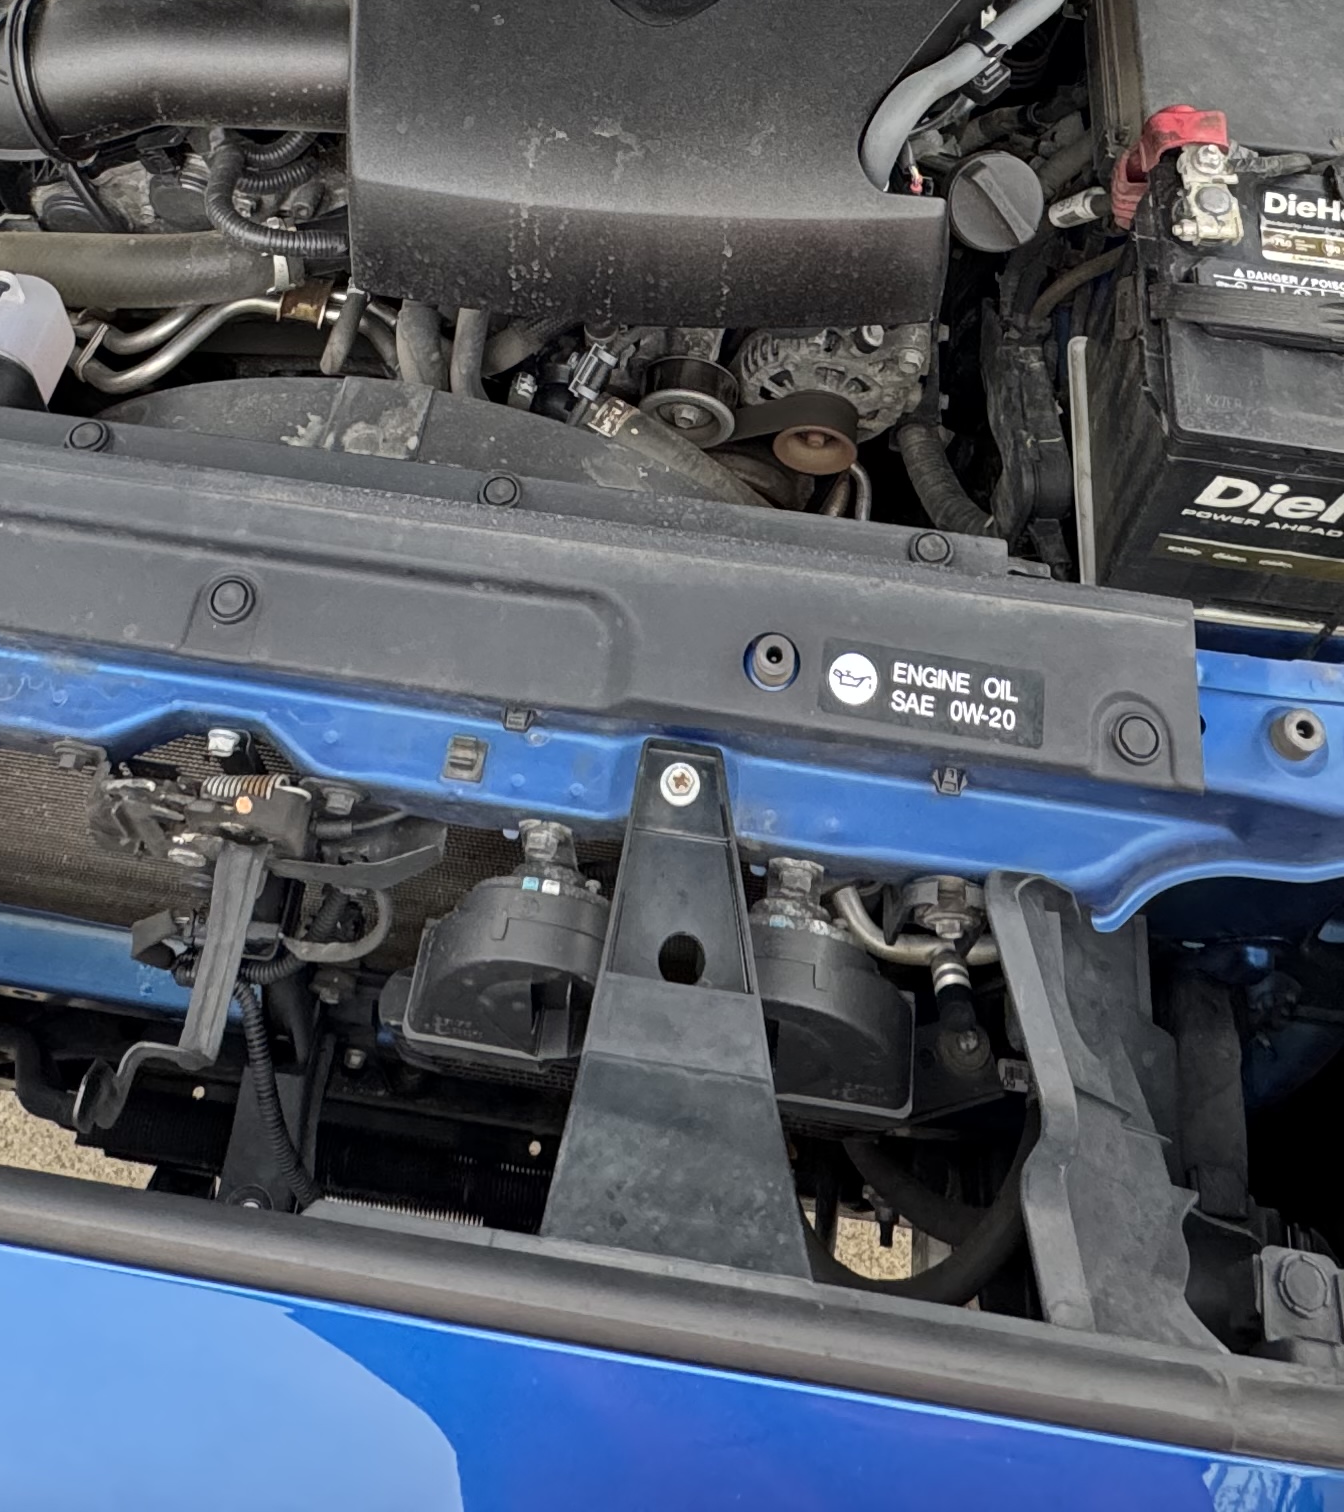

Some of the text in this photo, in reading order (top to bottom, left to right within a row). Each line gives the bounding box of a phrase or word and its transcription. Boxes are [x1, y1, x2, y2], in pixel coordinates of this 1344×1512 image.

[1246, 269, 1299, 286] DANGER
[1181, 508, 1261, 527] POWER
[892, 661, 1019, 703] ENGINE OIL
[890, 689, 1017, 731] SAE 0W-20
